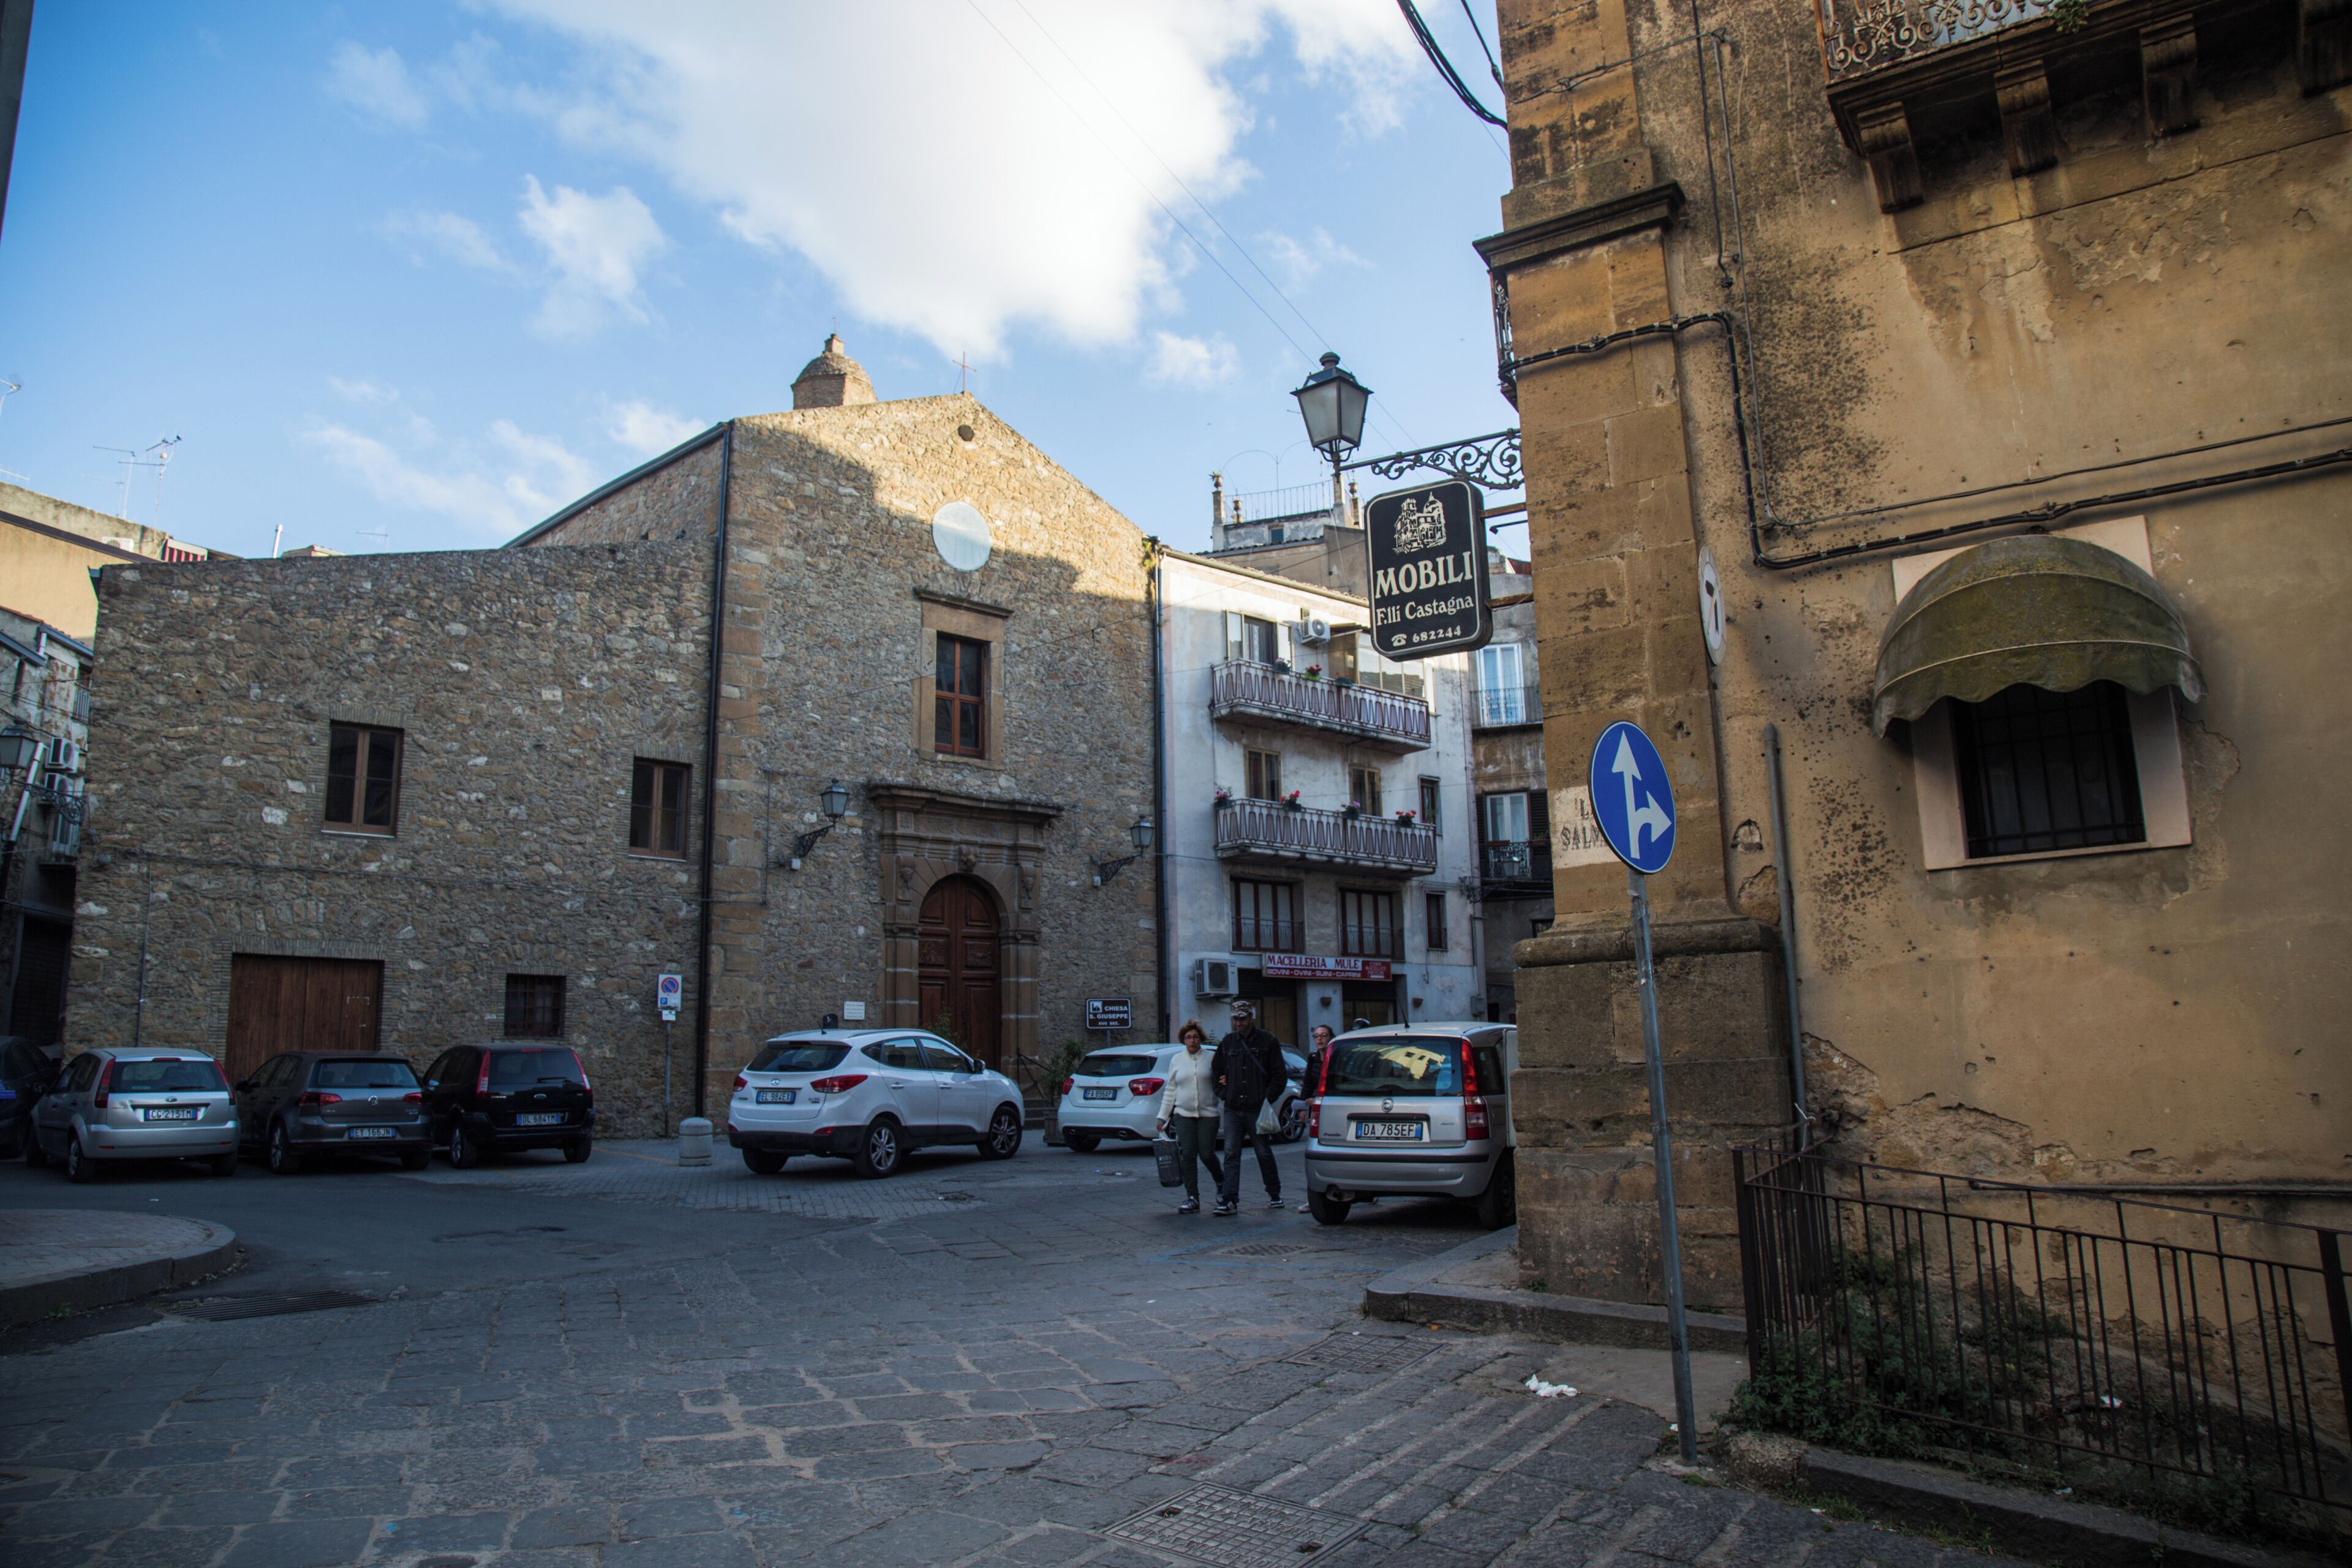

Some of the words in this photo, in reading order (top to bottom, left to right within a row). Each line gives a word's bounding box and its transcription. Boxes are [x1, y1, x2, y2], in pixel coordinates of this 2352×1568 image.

[1375, 551, 1473, 598] MOBILI
[1376, 605, 1401, 625] F.lli
[1405, 595, 1474, 619] Castagna
[1412, 625, 1461, 643] 682244
[1267, 955, 1327, 968] MACELLERIA
[165, 1109, 192, 1118] 213TM
[522, 1115, 532, 1123] DL
[355, 1128, 365, 1137] EY
[1363, 1123, 1376, 1136] DA
[1381, 1124, 1415, 1136] 785EF
